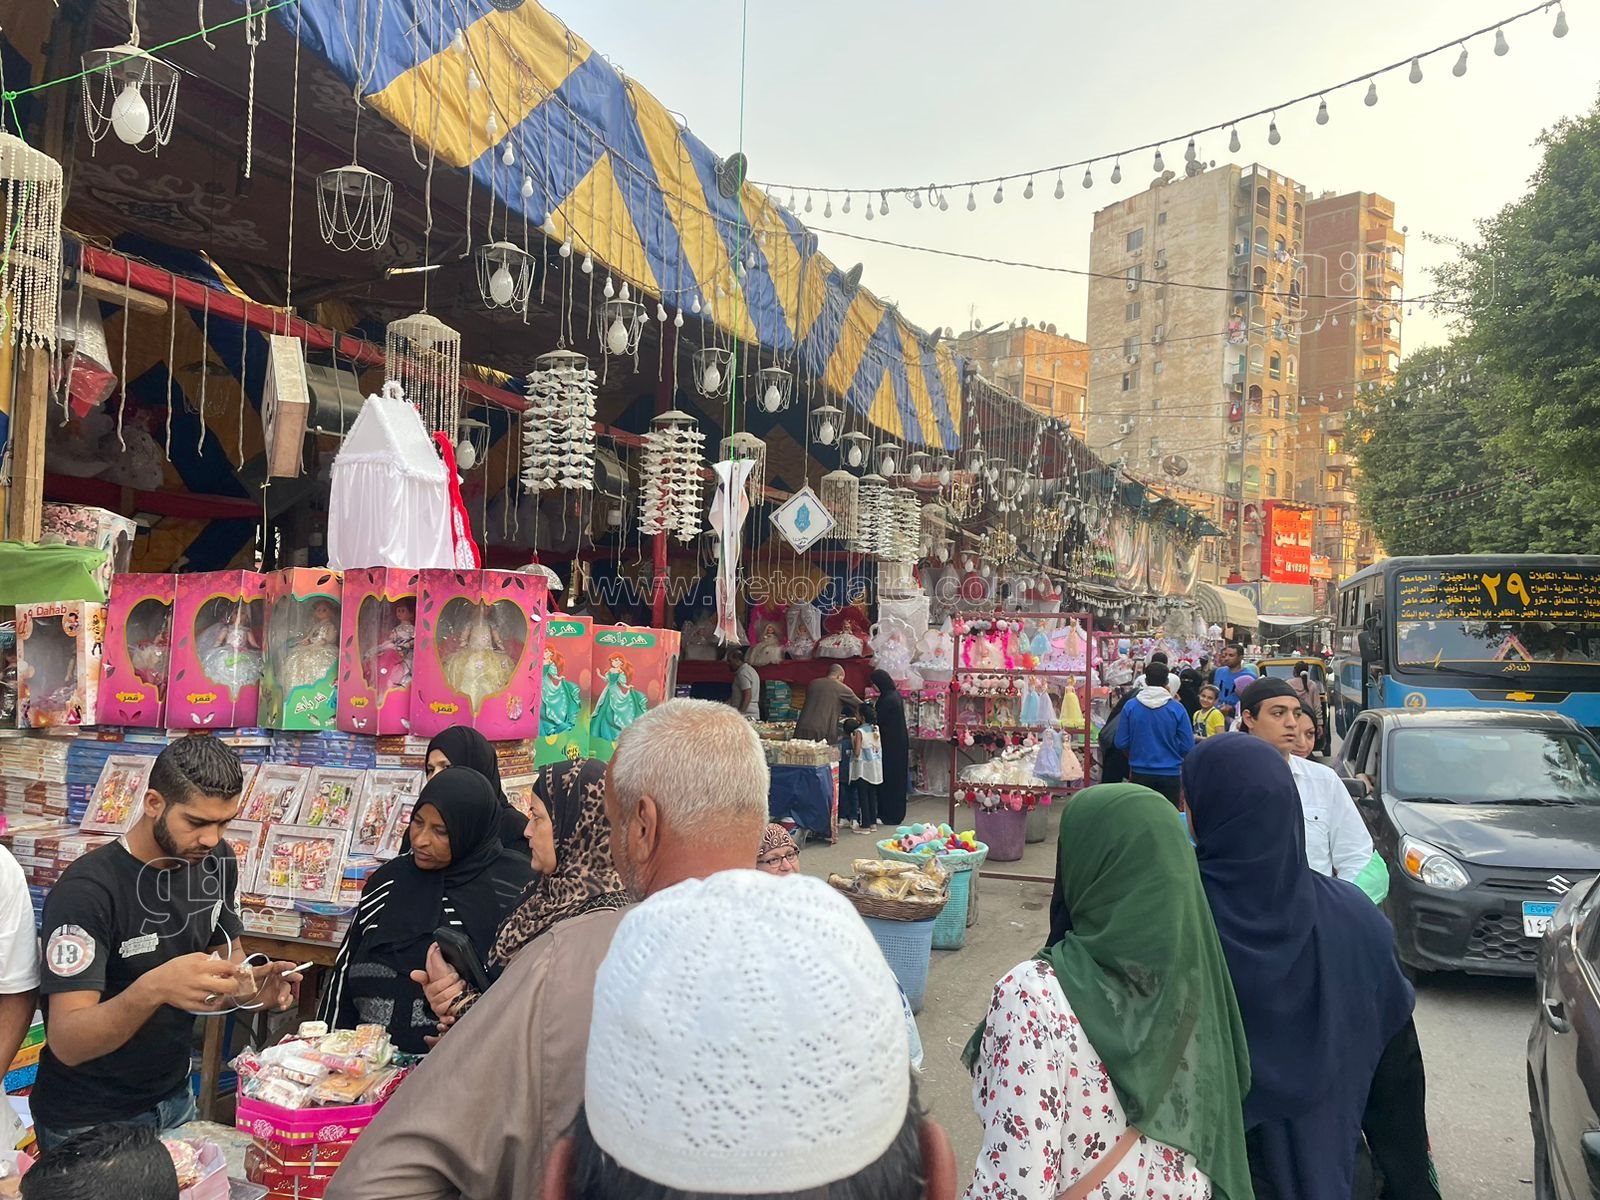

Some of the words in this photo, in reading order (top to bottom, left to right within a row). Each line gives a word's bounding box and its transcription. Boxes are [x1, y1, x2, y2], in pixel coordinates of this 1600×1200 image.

[1400, 574, 1431, 583] الجامعة
[1440, 572, 1471, 582] الجيزة
[1420, 584, 1438, 593] القصر
[1443, 584, 1459, 593] زينب
[1459, 583, 1480, 593] السيدة
[1401, 597, 1418, 606] ماهر
[1445, 595, 1466, 605] الخلق
[1468, 595, 1481, 604] باب
[36, 605, 68, 616] Dahab
[56, 944, 79, 965] 13
